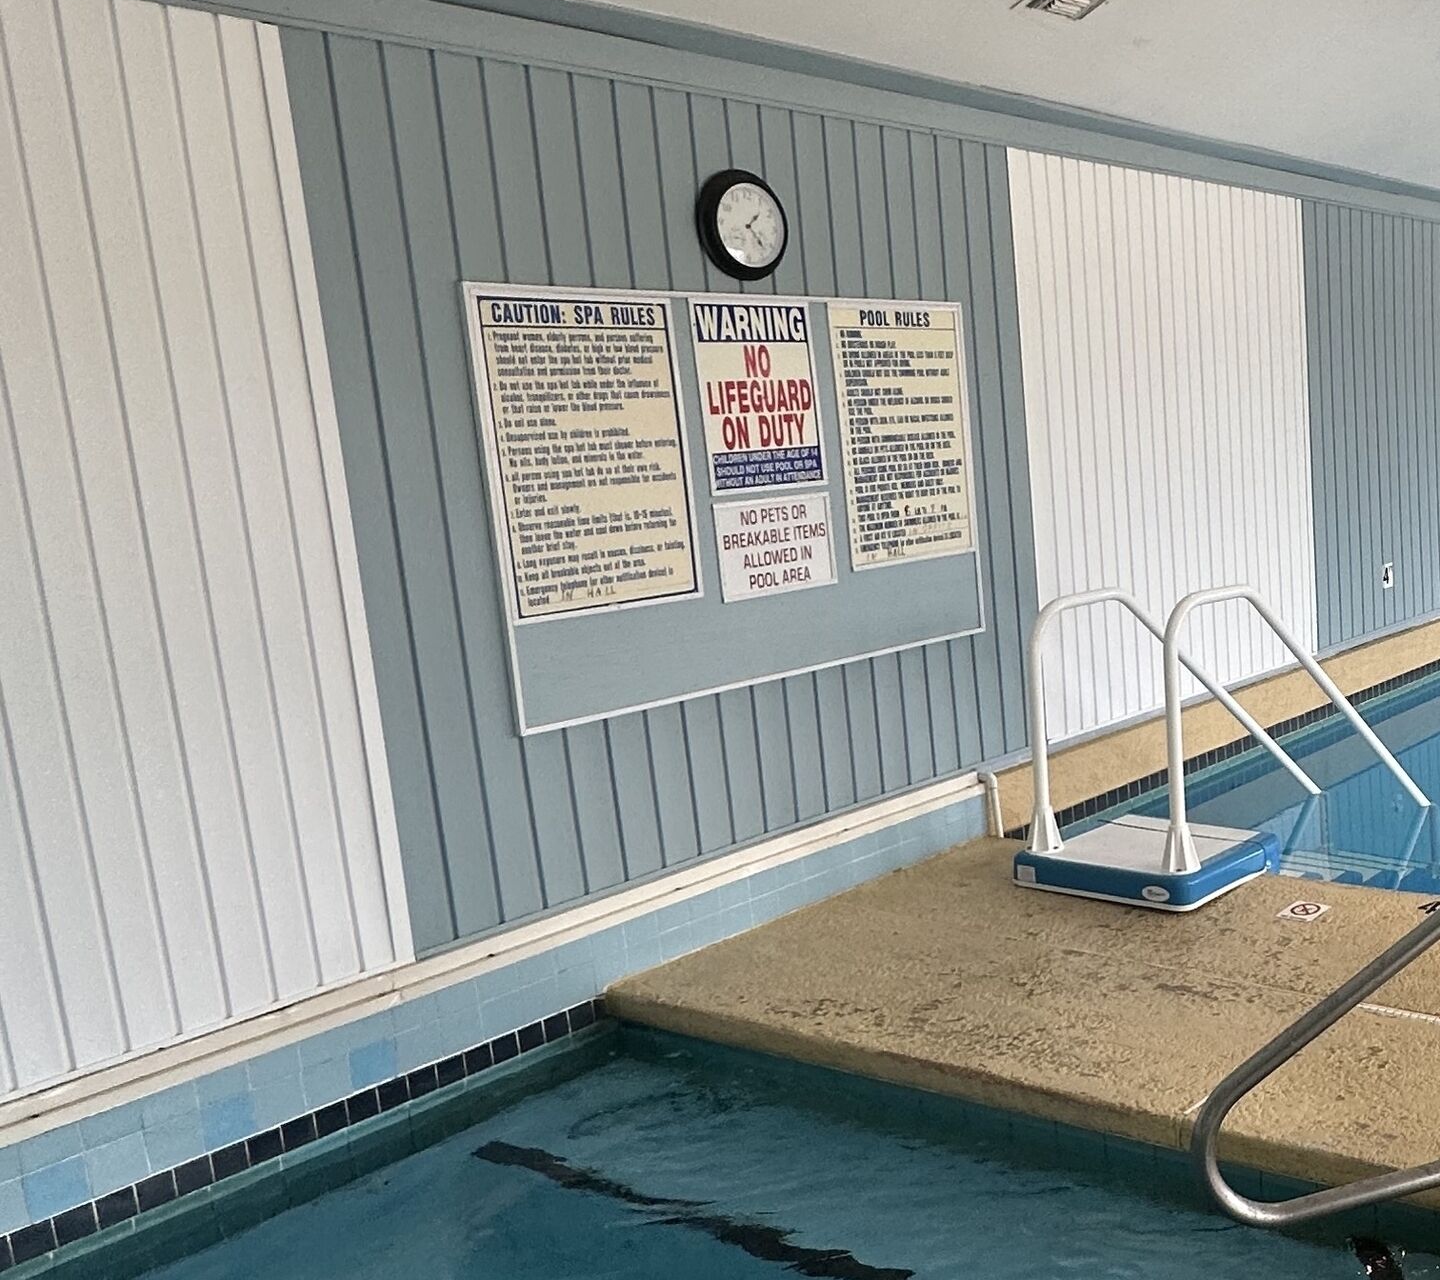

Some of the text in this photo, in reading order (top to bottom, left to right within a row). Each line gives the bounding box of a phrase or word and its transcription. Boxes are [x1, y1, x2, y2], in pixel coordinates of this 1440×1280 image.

[491, 302, 656, 326] CAUTION: SPA RULES
[695, 305, 806, 341] WARNING
[860, 310, 931, 327] POOL RULES
[743, 344, 771, 378] NO
[707, 379, 811, 415] LIFEGUARD
[722, 413, 805, 450] ON DUTY
[713, 454, 748, 465] CHILDREN
[749, 452, 772, 462] UNDER
[772, 451, 785, 460] THE
[786, 449, 800, 459] AGE
[801, 448, 810, 457] OF
[716, 459, 818, 477] SHOULD NOT USE POOL OR SPA
[744, 476, 754, 485] AN
[754, 474, 775, 484] ADULT
[776, 473, 783, 482] IN
[783, 469, 821, 481] ATTENDANCE
[740, 504, 807, 526] NO PETS OR
[723, 522, 826, 550] BREAKABLE ITEMS
[743, 545, 812, 569] ALLOWED IN
[749, 566, 812, 589] POOL AREA
